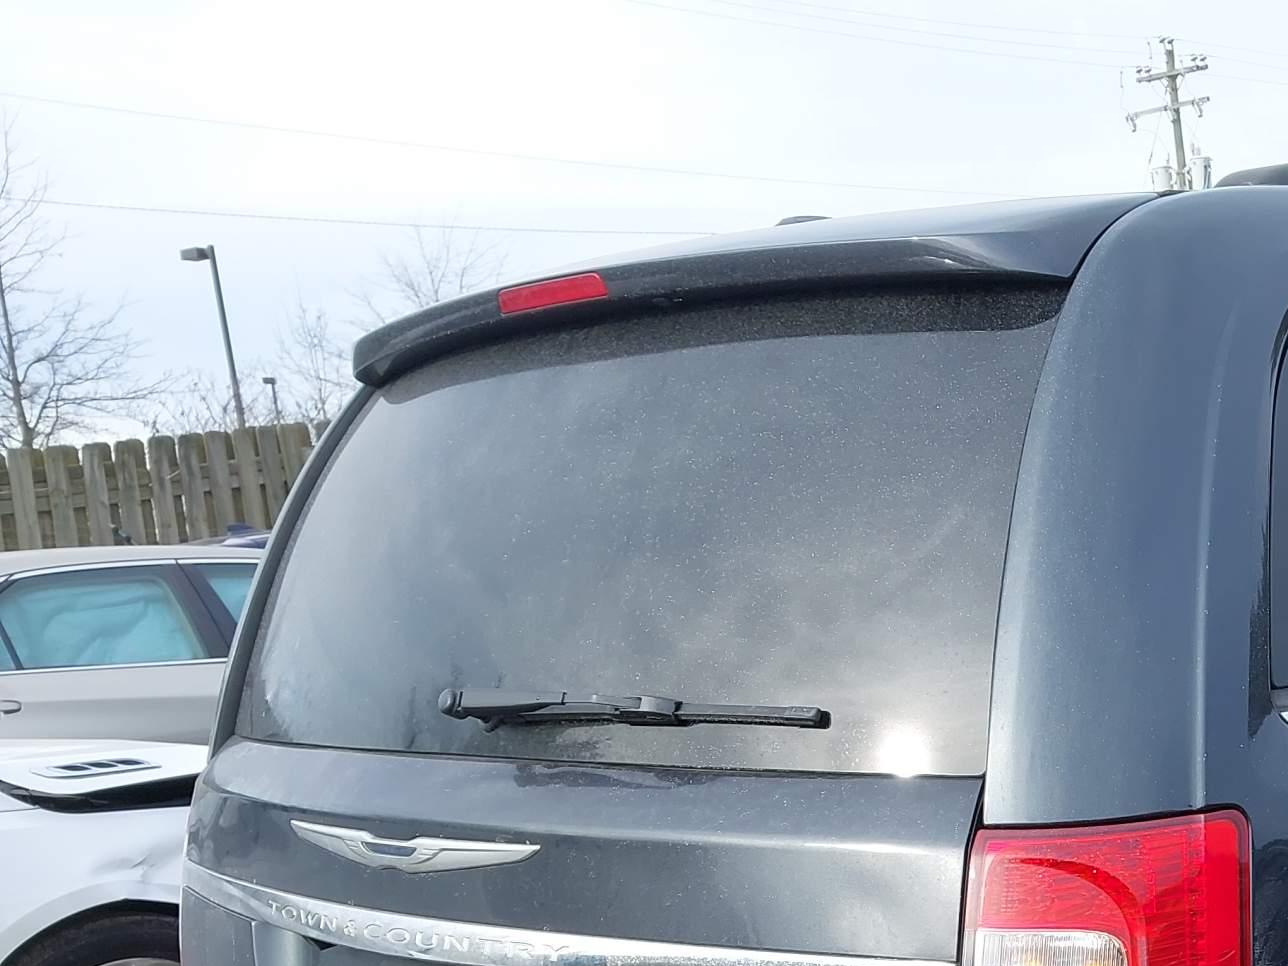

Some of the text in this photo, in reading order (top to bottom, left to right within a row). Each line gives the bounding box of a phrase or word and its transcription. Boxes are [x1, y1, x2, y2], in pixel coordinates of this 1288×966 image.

[267, 898, 569, 962] TOWN & COUNTRY
